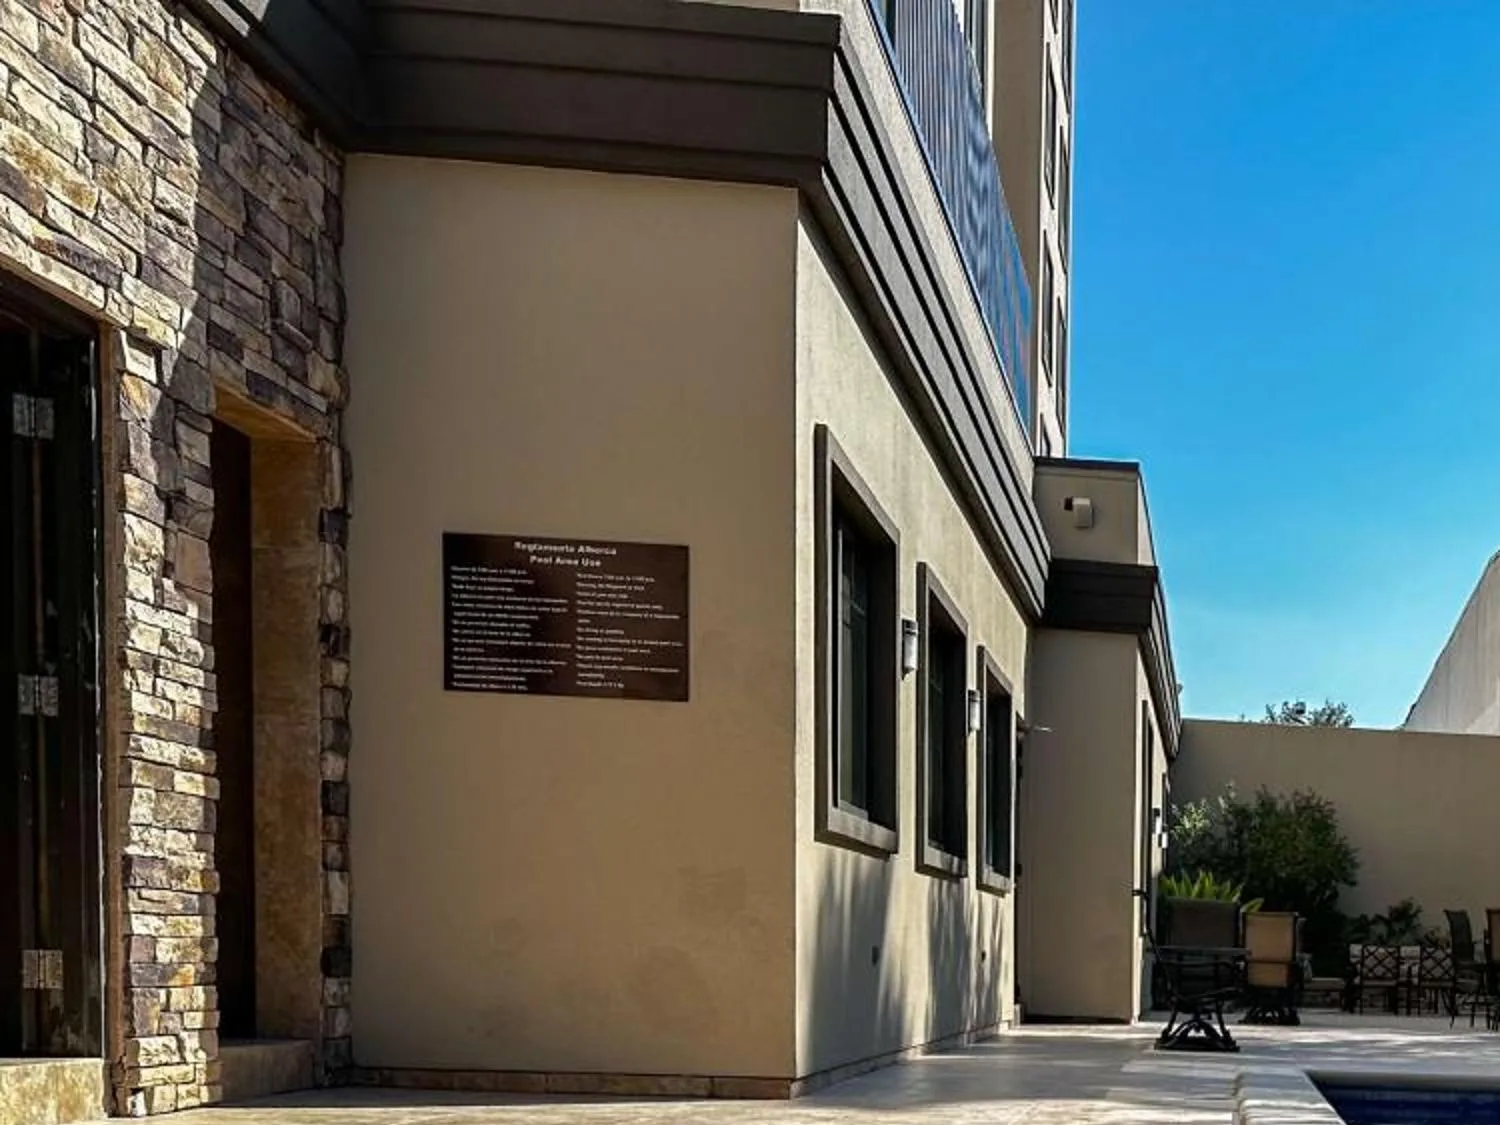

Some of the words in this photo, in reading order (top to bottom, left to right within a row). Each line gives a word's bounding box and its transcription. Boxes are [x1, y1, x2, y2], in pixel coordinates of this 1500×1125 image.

[529, 555, 553, 564] Pool
[555, 556, 579, 566] Area
[581, 557, 602, 567] Use
